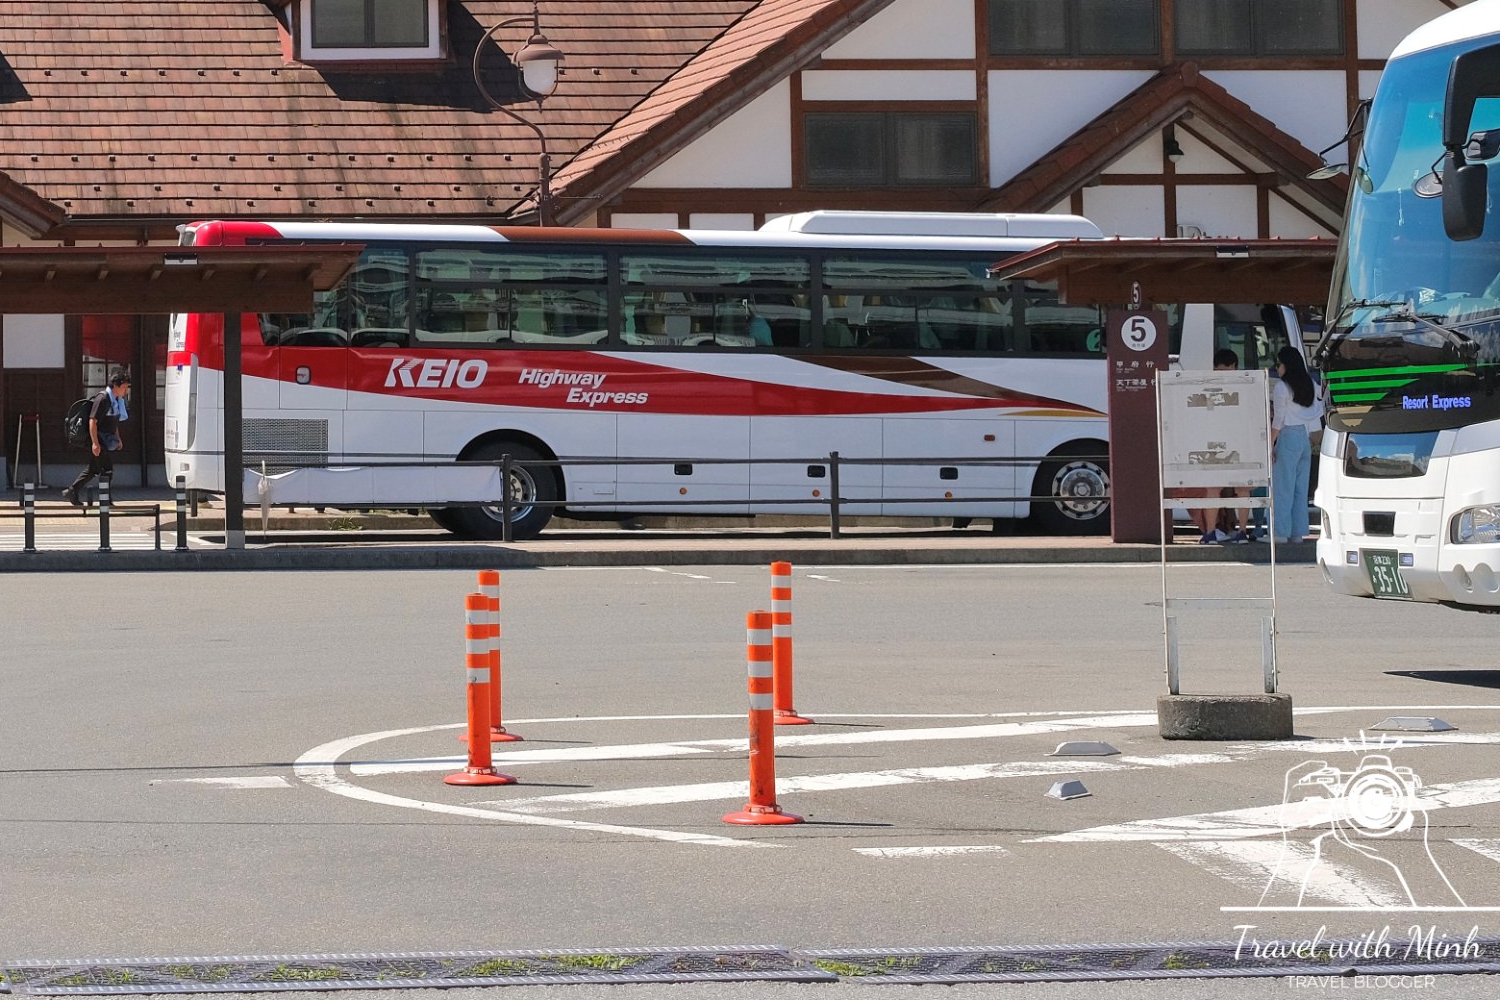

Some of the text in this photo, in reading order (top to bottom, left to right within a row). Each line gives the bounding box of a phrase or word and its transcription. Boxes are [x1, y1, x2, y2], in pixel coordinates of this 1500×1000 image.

[1130, 318, 1147, 342] 5
[384, 358, 488, 389] KEIO
[518, 368, 606, 388] Highway
[566, 387, 648, 407] Express
[1402, 394, 1472, 412] Resort Express
